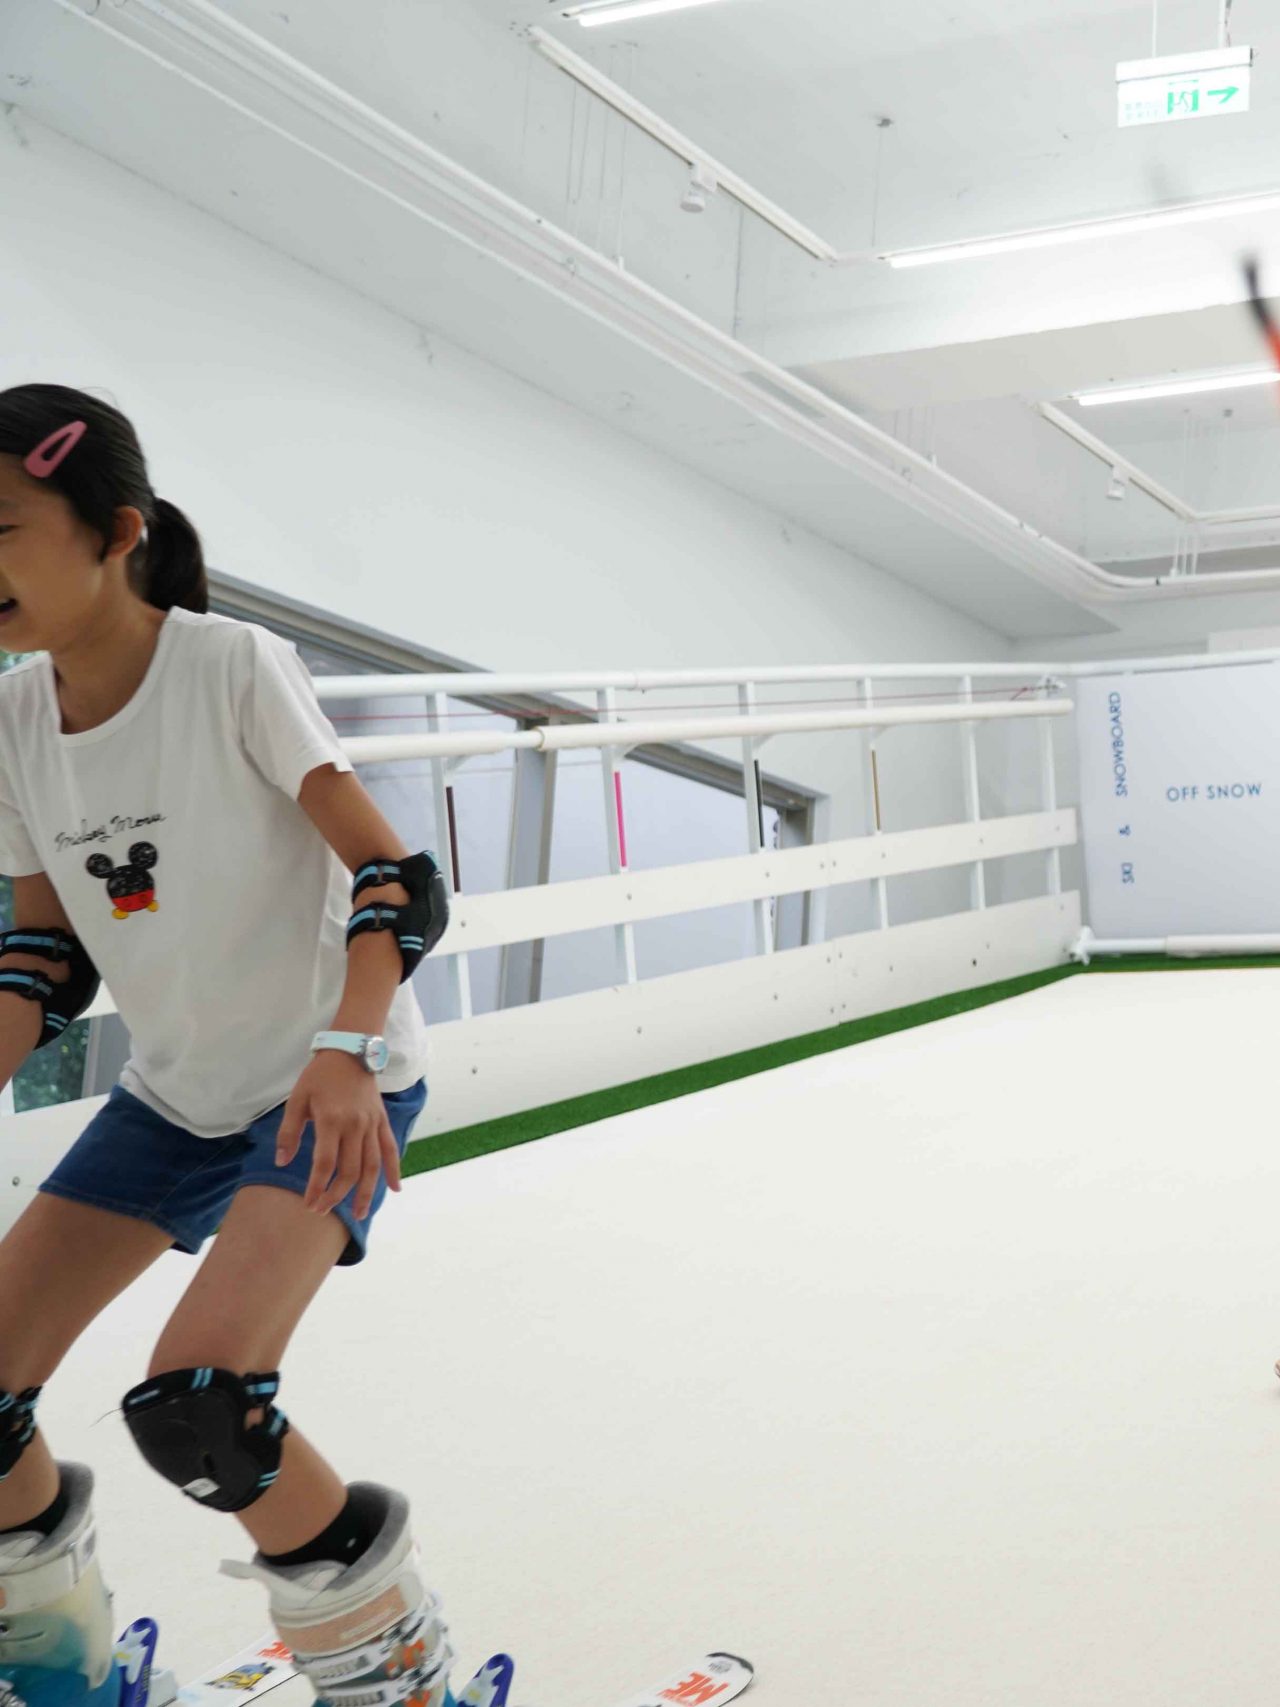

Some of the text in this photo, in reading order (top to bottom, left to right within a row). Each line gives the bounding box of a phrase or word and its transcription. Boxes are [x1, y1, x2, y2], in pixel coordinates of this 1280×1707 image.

[1108, 691, 1128, 797] SNOWBOARD
[1166, 783, 1262, 802] OFF SNOW
[1121, 862, 1135, 884] SKI
